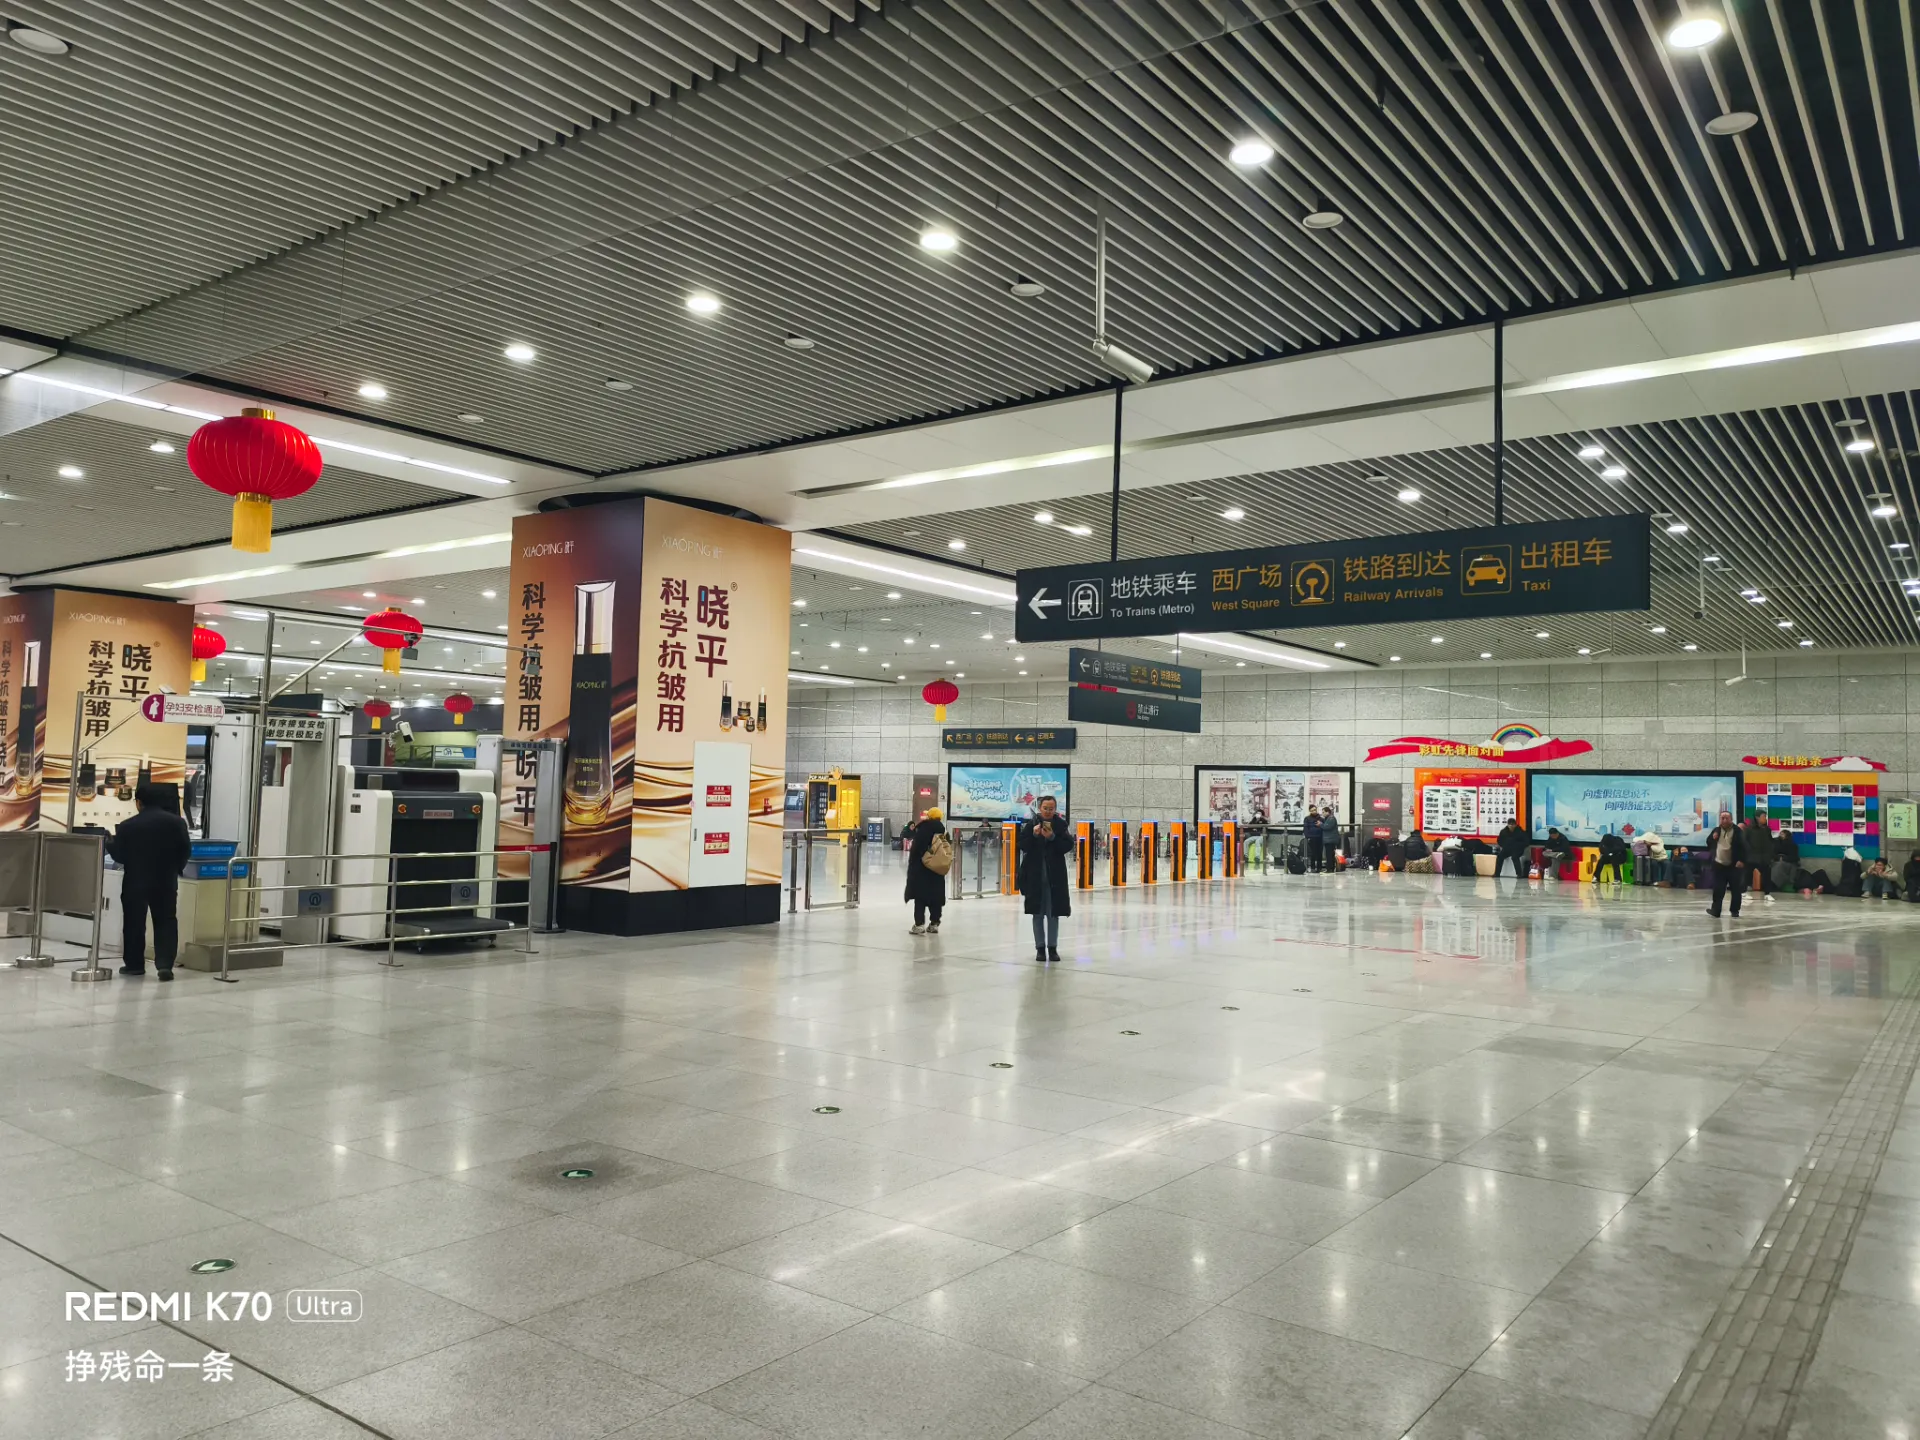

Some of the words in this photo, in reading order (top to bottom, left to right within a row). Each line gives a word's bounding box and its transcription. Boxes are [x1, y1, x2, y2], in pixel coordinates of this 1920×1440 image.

[523, 542, 563, 558] XIAOPING
[662, 534, 711, 557] XIAOPING
[1521, 537, 1613, 570] 出租车
[1343, 549, 1452, 582] 铁路到达
[1110, 570, 1197, 600] 地铁乘车
[1212, 563, 1282, 592] 西广场
[1522, 580, 1551, 592] Taxi
[1344, 590, 1391, 603] Railway
[1394, 587, 1444, 600] Arrivals
[1110, 608, 1123, 618] To
[1125, 606, 1156, 617] Trains
[1158, 603, 1195, 616] (Metro)
[1211, 599, 1239, 611] West
[1241, 597, 1280, 610] Square
[695, 584, 729, 678] 晓平
[656, 577, 690, 733] 科学抗皱用
[120, 644, 152, 703] 晓平
[84, 640, 115, 737] 科学抗皱用
[165, 702, 223, 716] 孕妇安检通道
[268, 718, 325, 730] 有序接受安检
[1419, 743, 1505, 757] 彩虹先锋面对面
[1582, 787, 1650, 801] 向虚假信息说不
[1604, 799, 1674, 813] 向网络谣言亮剑
